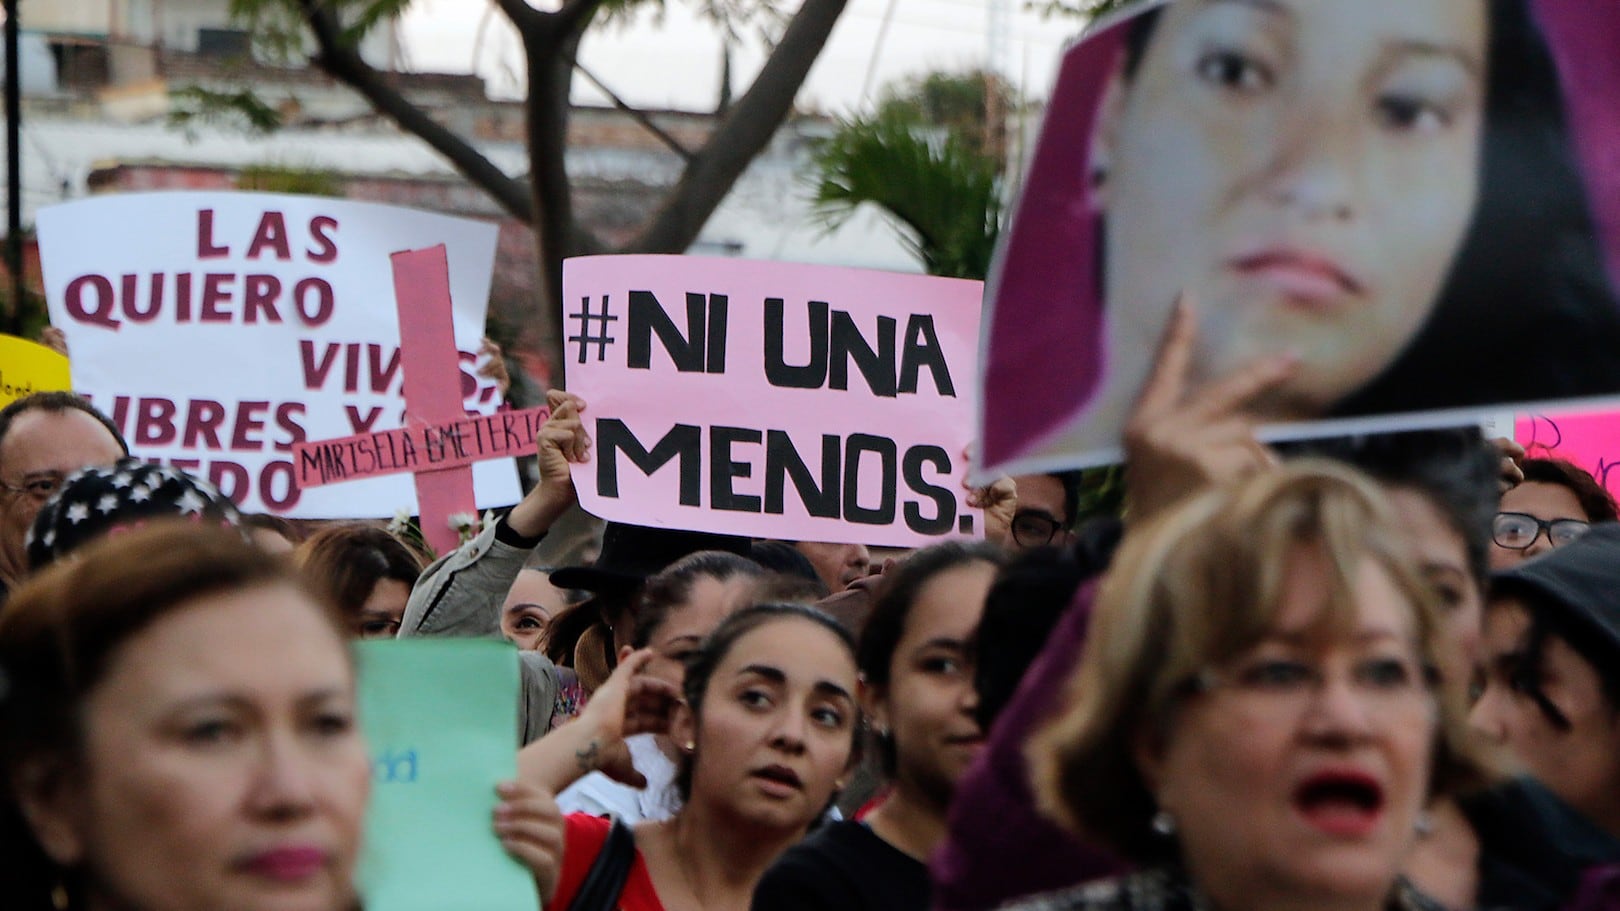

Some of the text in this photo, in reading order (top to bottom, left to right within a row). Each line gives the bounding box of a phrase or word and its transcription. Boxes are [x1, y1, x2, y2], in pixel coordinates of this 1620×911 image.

[197, 209, 339, 263] LAS
[64, 273, 335, 332] QUIERO
[300, 340, 496, 404] VIVS,
[568, 290, 957, 398] #NI UNA
[80, 394, 306, 451] IBRES
[301, 432, 418, 484] MARISELA
[595, 418, 975, 535] MENOS.
